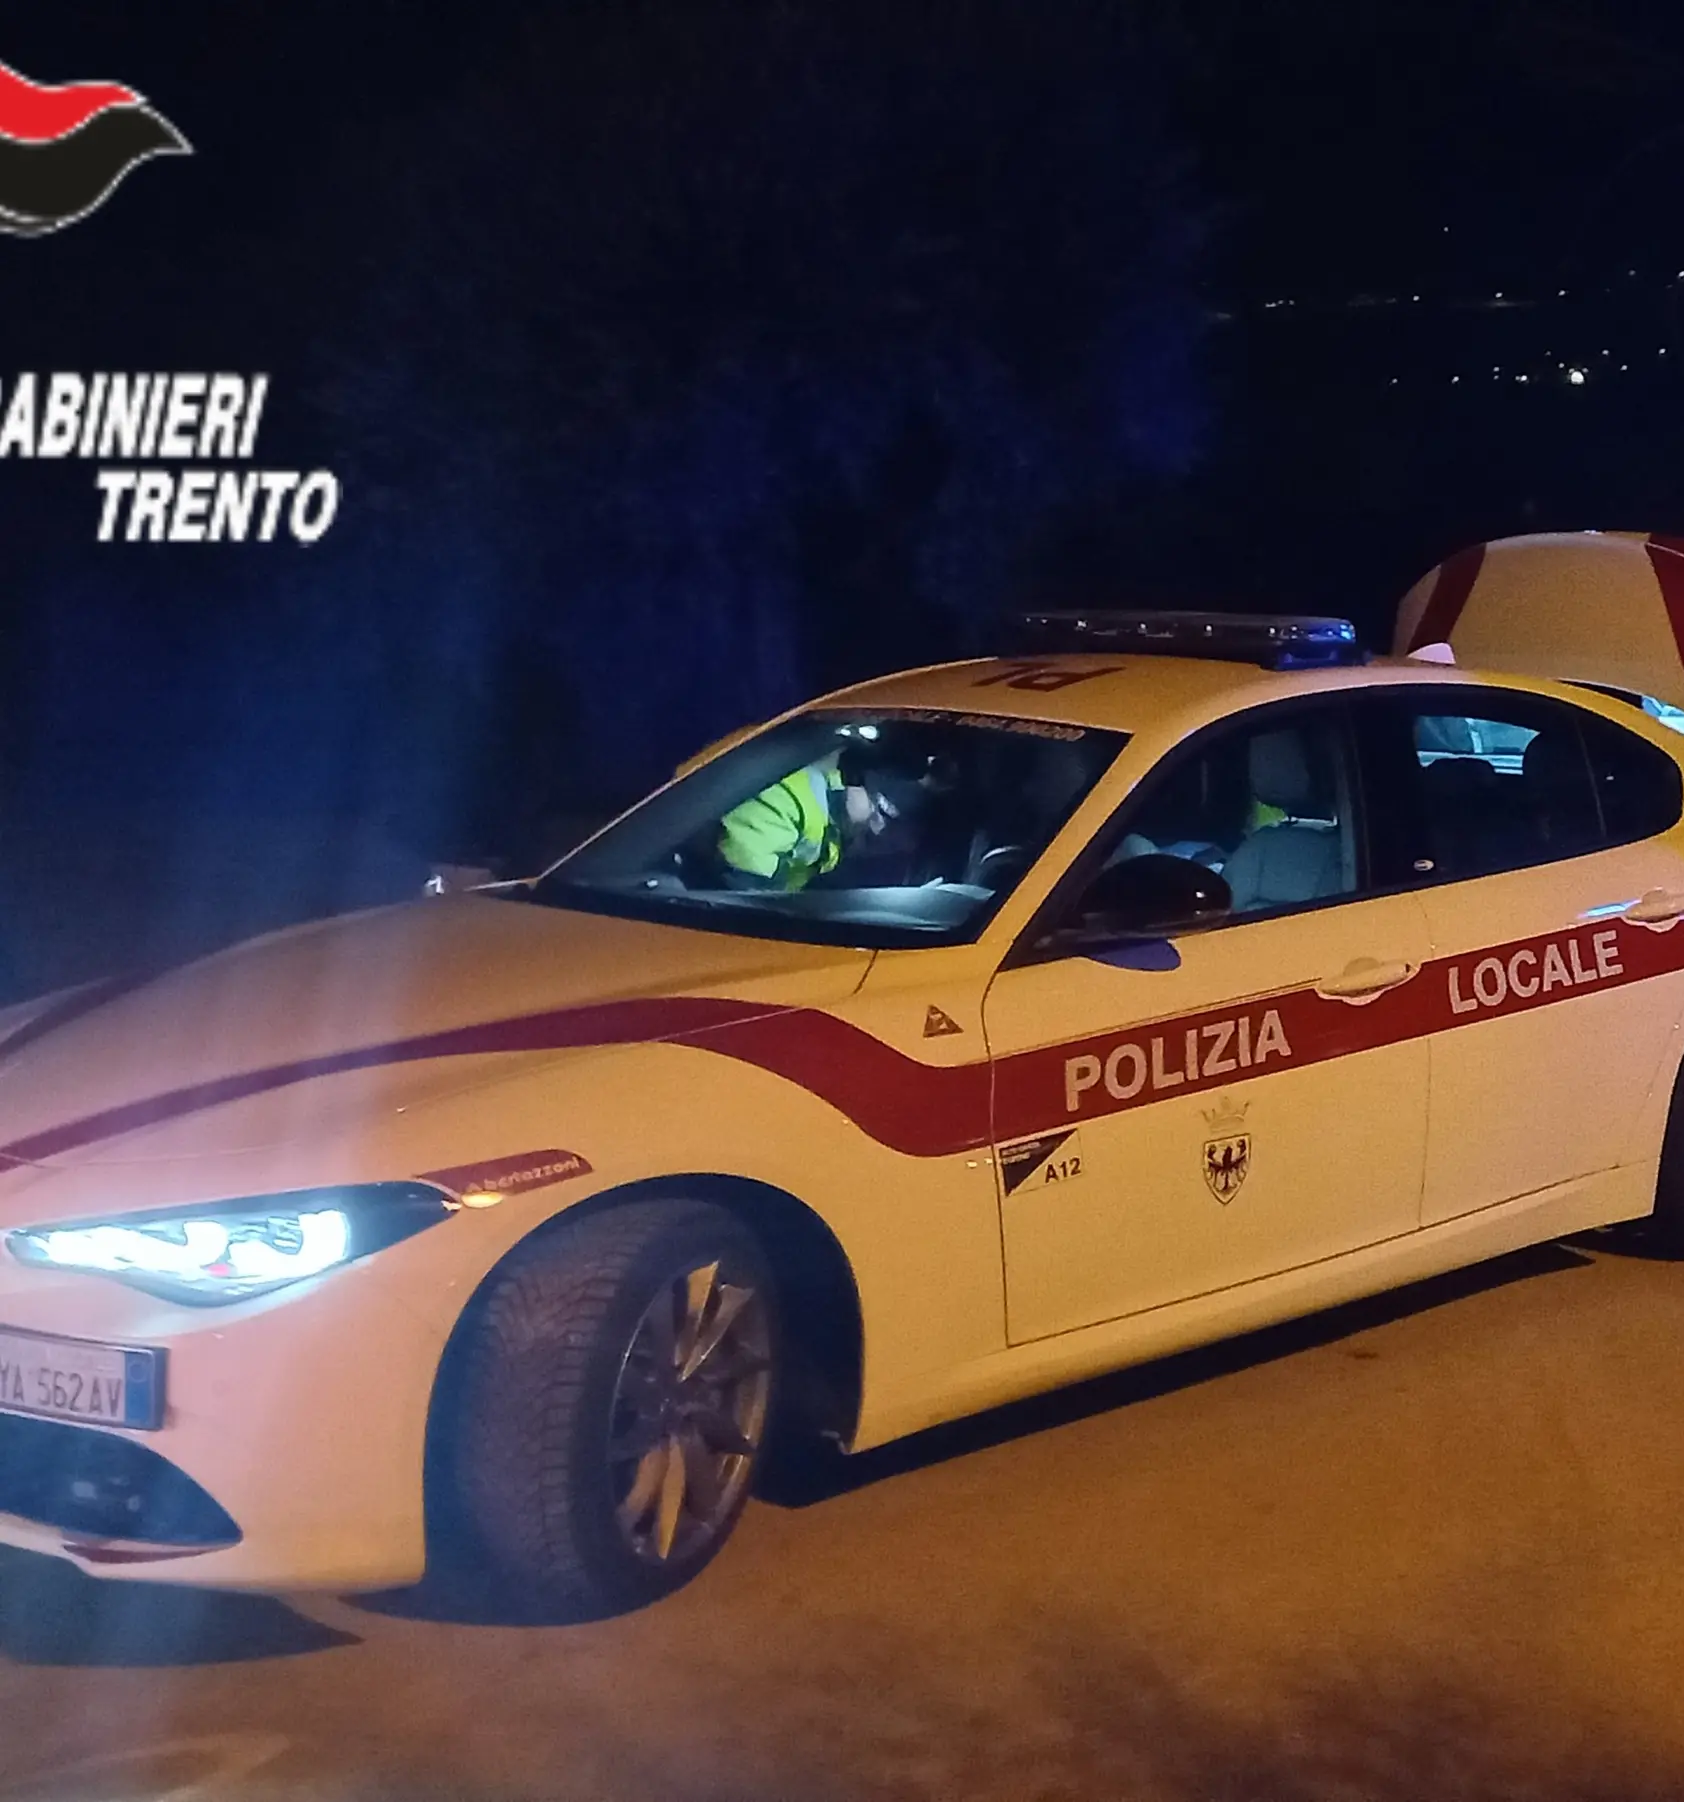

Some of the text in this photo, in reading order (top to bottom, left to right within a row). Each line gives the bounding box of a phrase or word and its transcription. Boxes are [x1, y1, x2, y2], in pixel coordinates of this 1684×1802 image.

[1064, 930, 1624, 1111] POLIZIA LOCALE
[1045, 1157, 1081, 1183] A12
